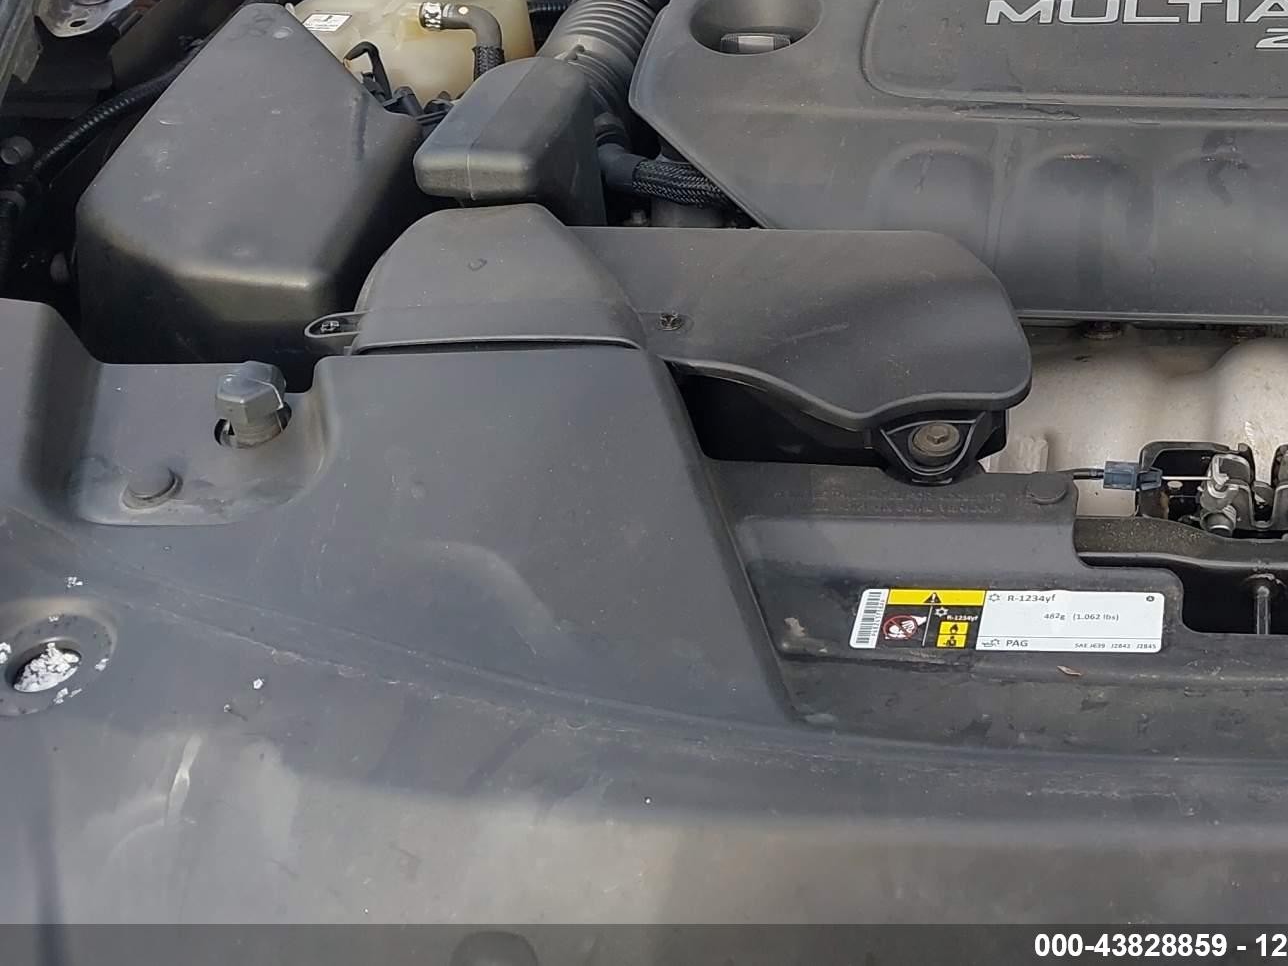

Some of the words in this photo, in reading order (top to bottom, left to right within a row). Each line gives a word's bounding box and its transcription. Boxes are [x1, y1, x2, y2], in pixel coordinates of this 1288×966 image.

[1007, 593, 1056, 604] R-1234yf
[1072, 613, 1101, 621] (1.062
[1005, 639, 1029, 647] PAG
